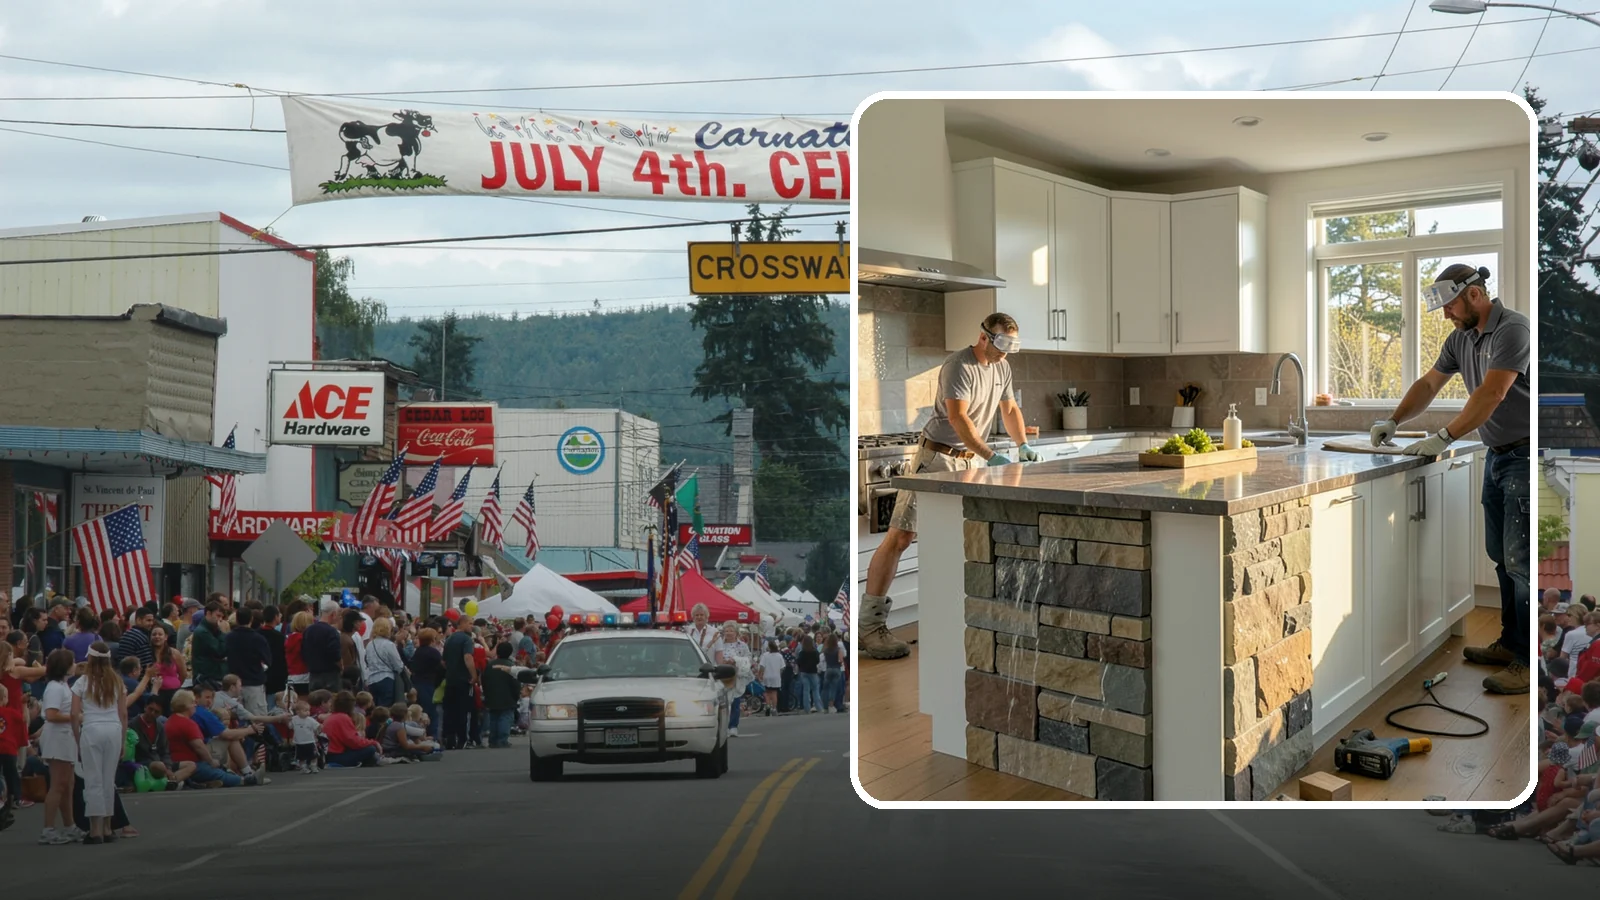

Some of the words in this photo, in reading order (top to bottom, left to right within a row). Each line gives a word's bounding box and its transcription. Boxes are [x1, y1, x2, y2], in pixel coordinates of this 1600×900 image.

[481, 141, 605, 192] JULY
[632, 148, 746, 197] 4th.
[697, 254, 850, 280] CROSSWA
[283, 380, 373, 420] ACE
[406, 409, 453, 422] CEDAR
[284, 421, 371, 436] Hardware
[417, 428, 477, 446] Coca-Cola
[83, 486, 93, 494] St.
[96, 485, 124, 495] Vincent
[126, 486, 135, 495] de
[137, 486, 155, 495] Paul
[688, 526, 741, 535] CRNATION
[700, 535, 730, 543] GLASS
